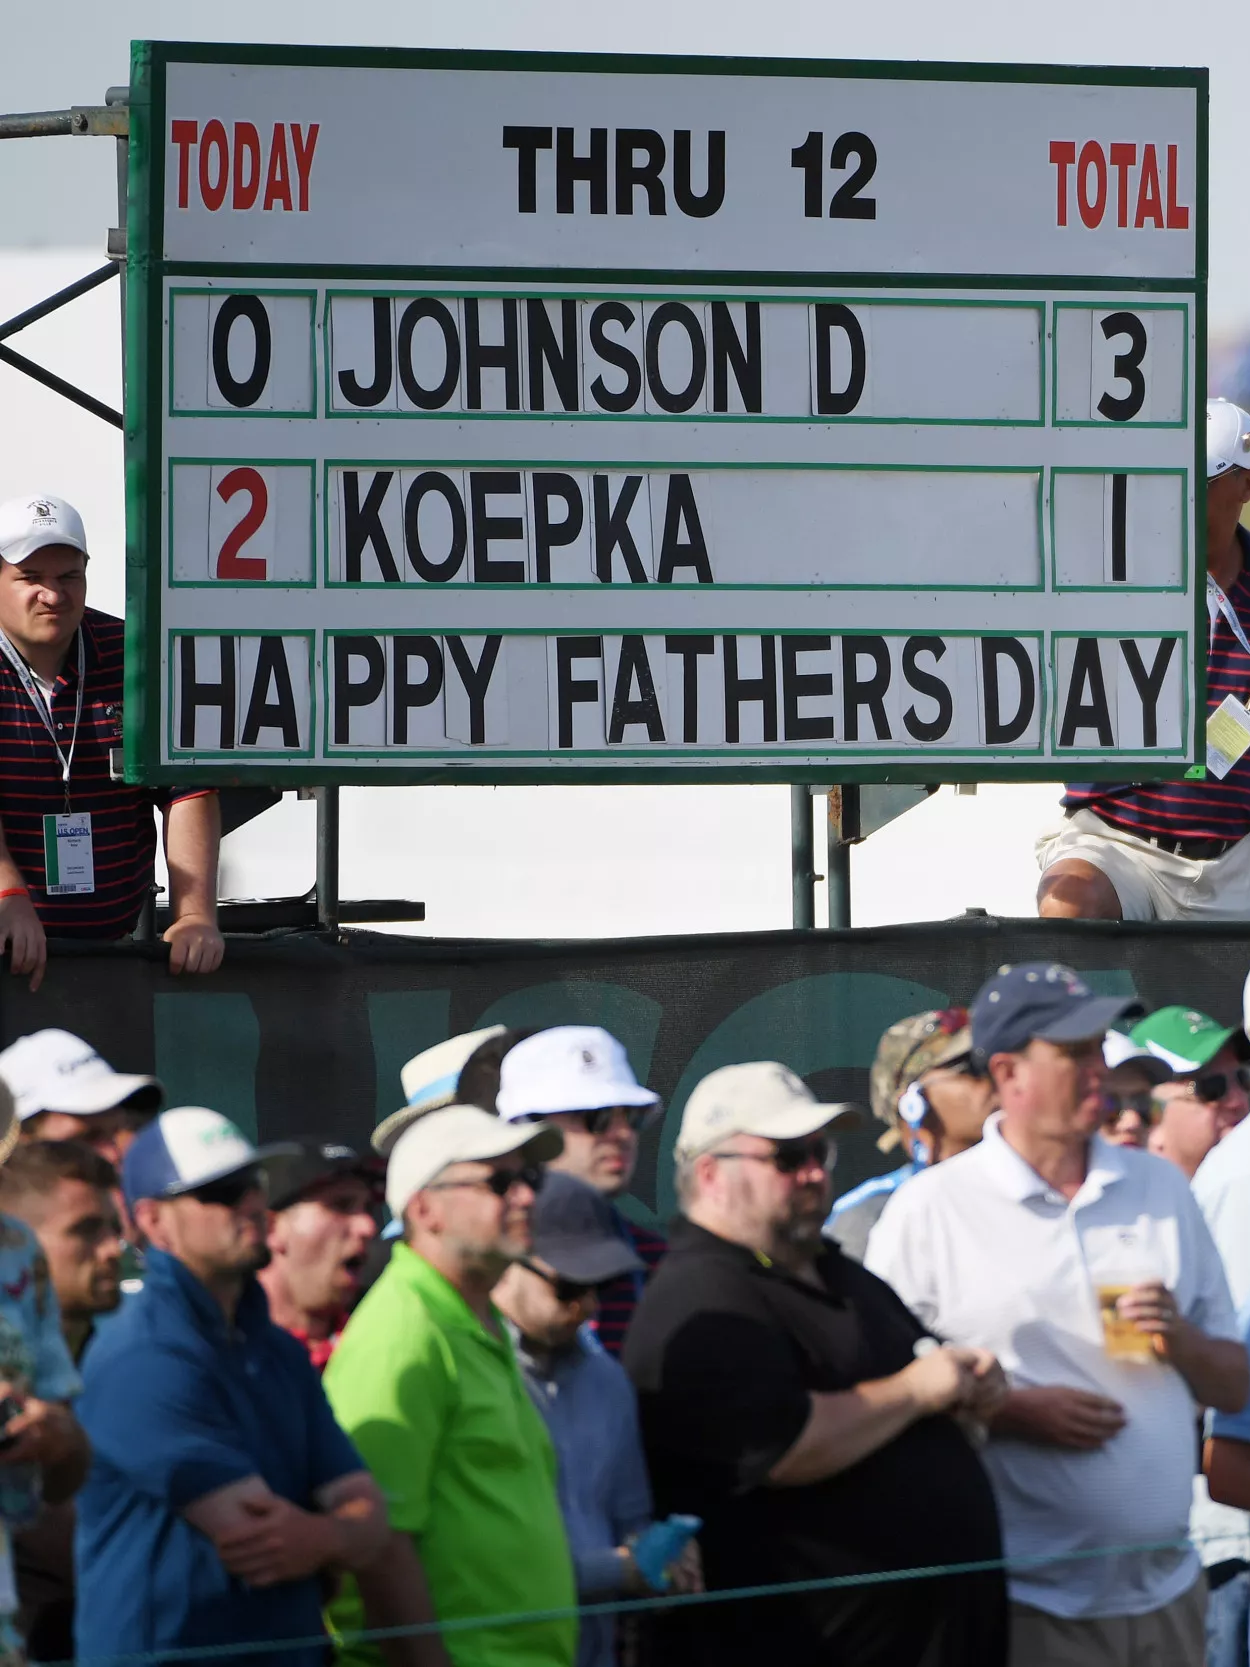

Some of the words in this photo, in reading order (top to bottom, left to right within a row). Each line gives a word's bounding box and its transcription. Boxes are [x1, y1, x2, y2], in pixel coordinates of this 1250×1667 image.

[171, 119, 320, 212] TODAY
[502, 125, 726, 218] THRU
[790, 131, 877, 220] 12
[1048, 140, 1190, 229] TOTAL
[337, 296, 762, 414] JOHNSON
[813, 302, 867, 415] D
[1097, 311, 1148, 421] 3
[215, 466, 268, 580] 2
[343, 471, 714, 584] KOEPKA
[556, 634, 953, 748] FATHERS
